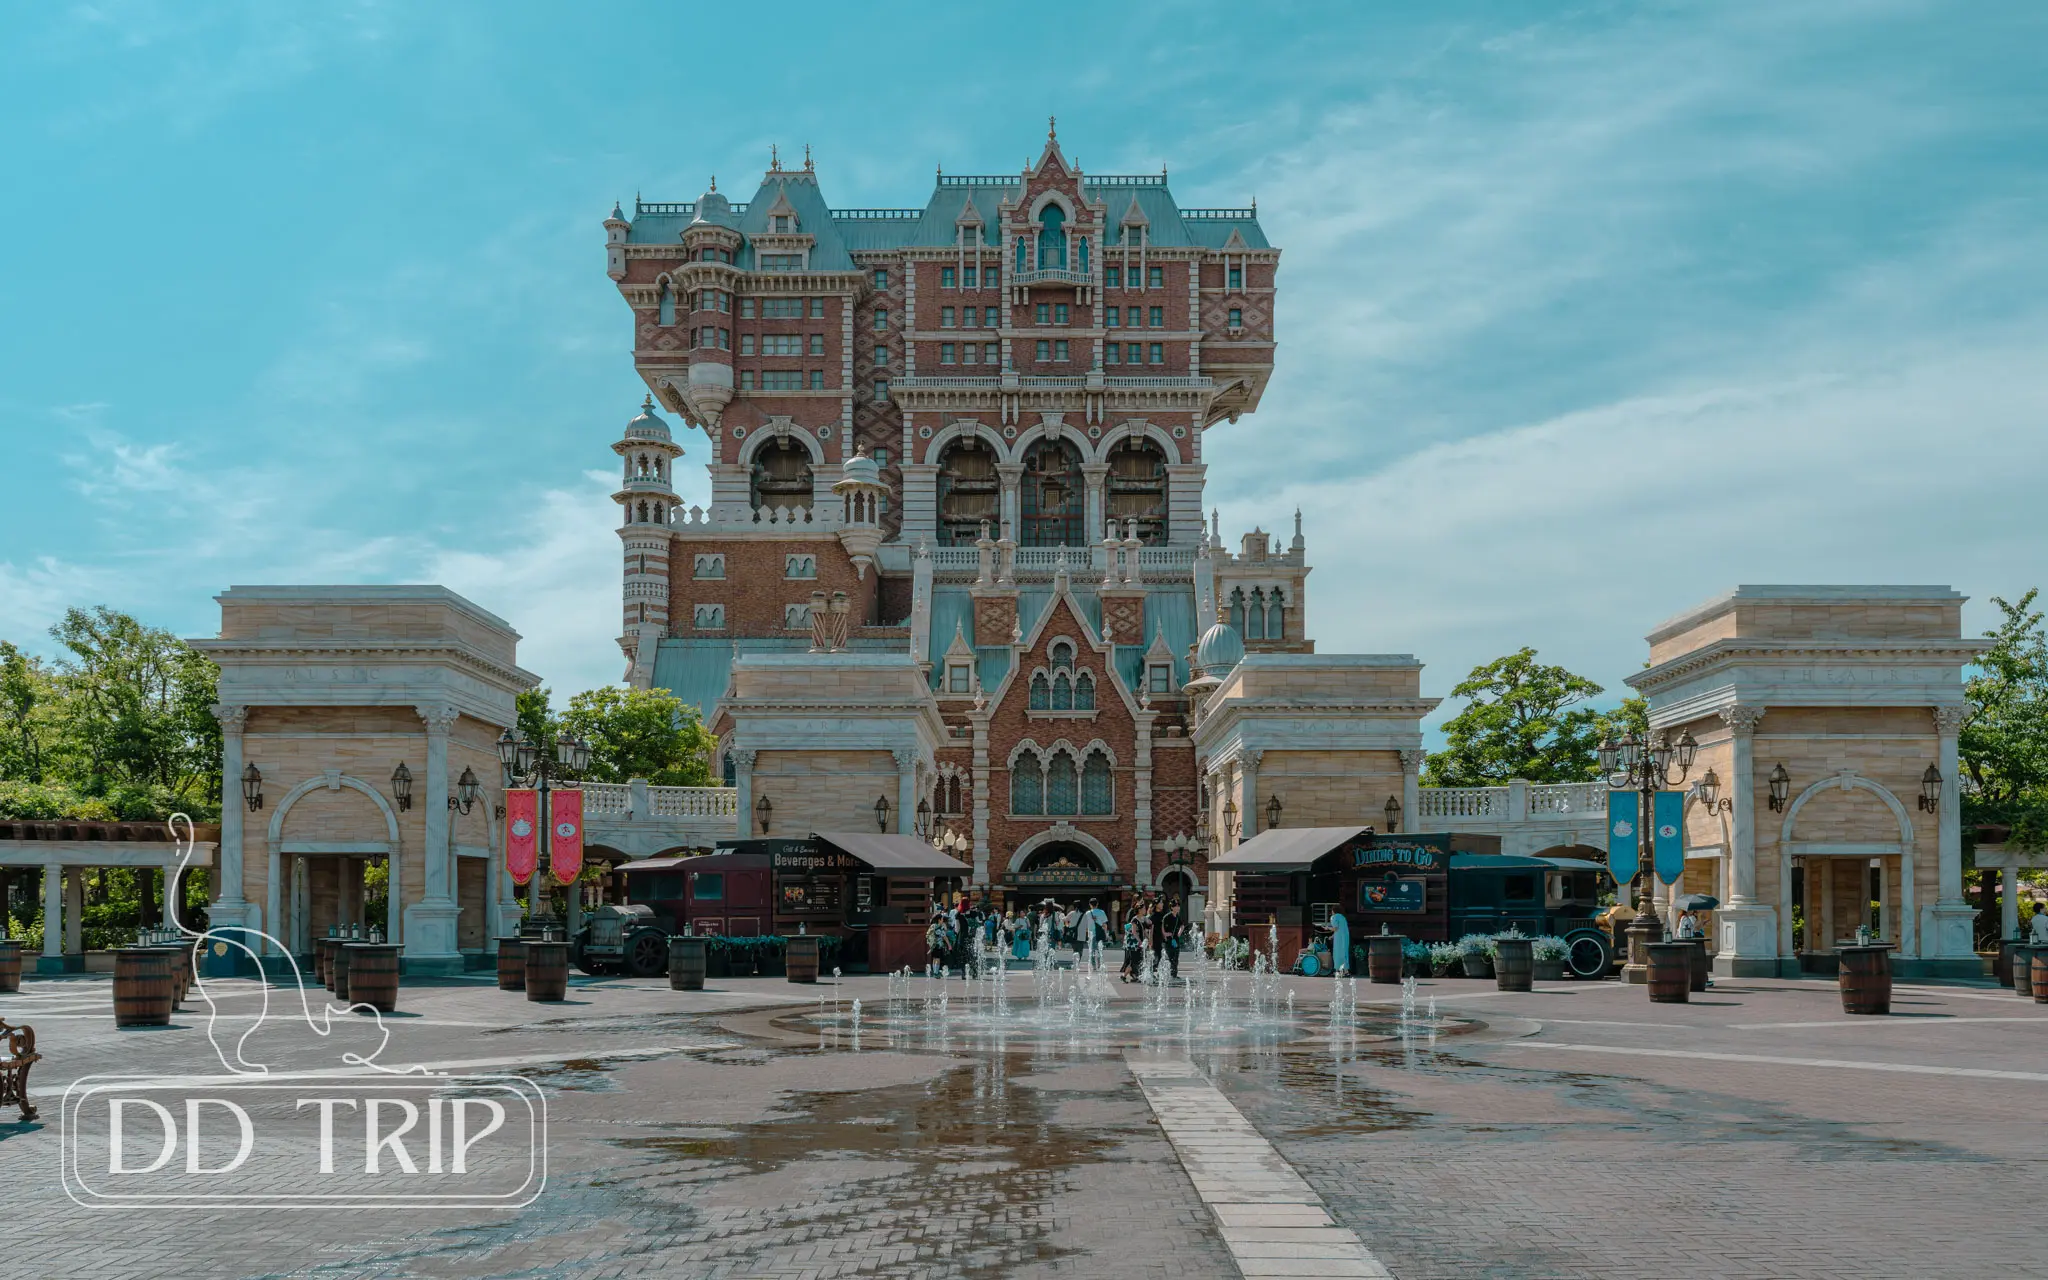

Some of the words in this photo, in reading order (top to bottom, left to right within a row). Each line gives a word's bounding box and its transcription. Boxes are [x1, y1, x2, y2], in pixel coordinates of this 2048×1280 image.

[284, 667, 380, 680] MUSIC
[1781, 669, 1922, 681] THEATRE
[774, 853, 825, 869] Beverages
[827, 855, 835, 867] &
[1397, 849, 1411, 862] TO
